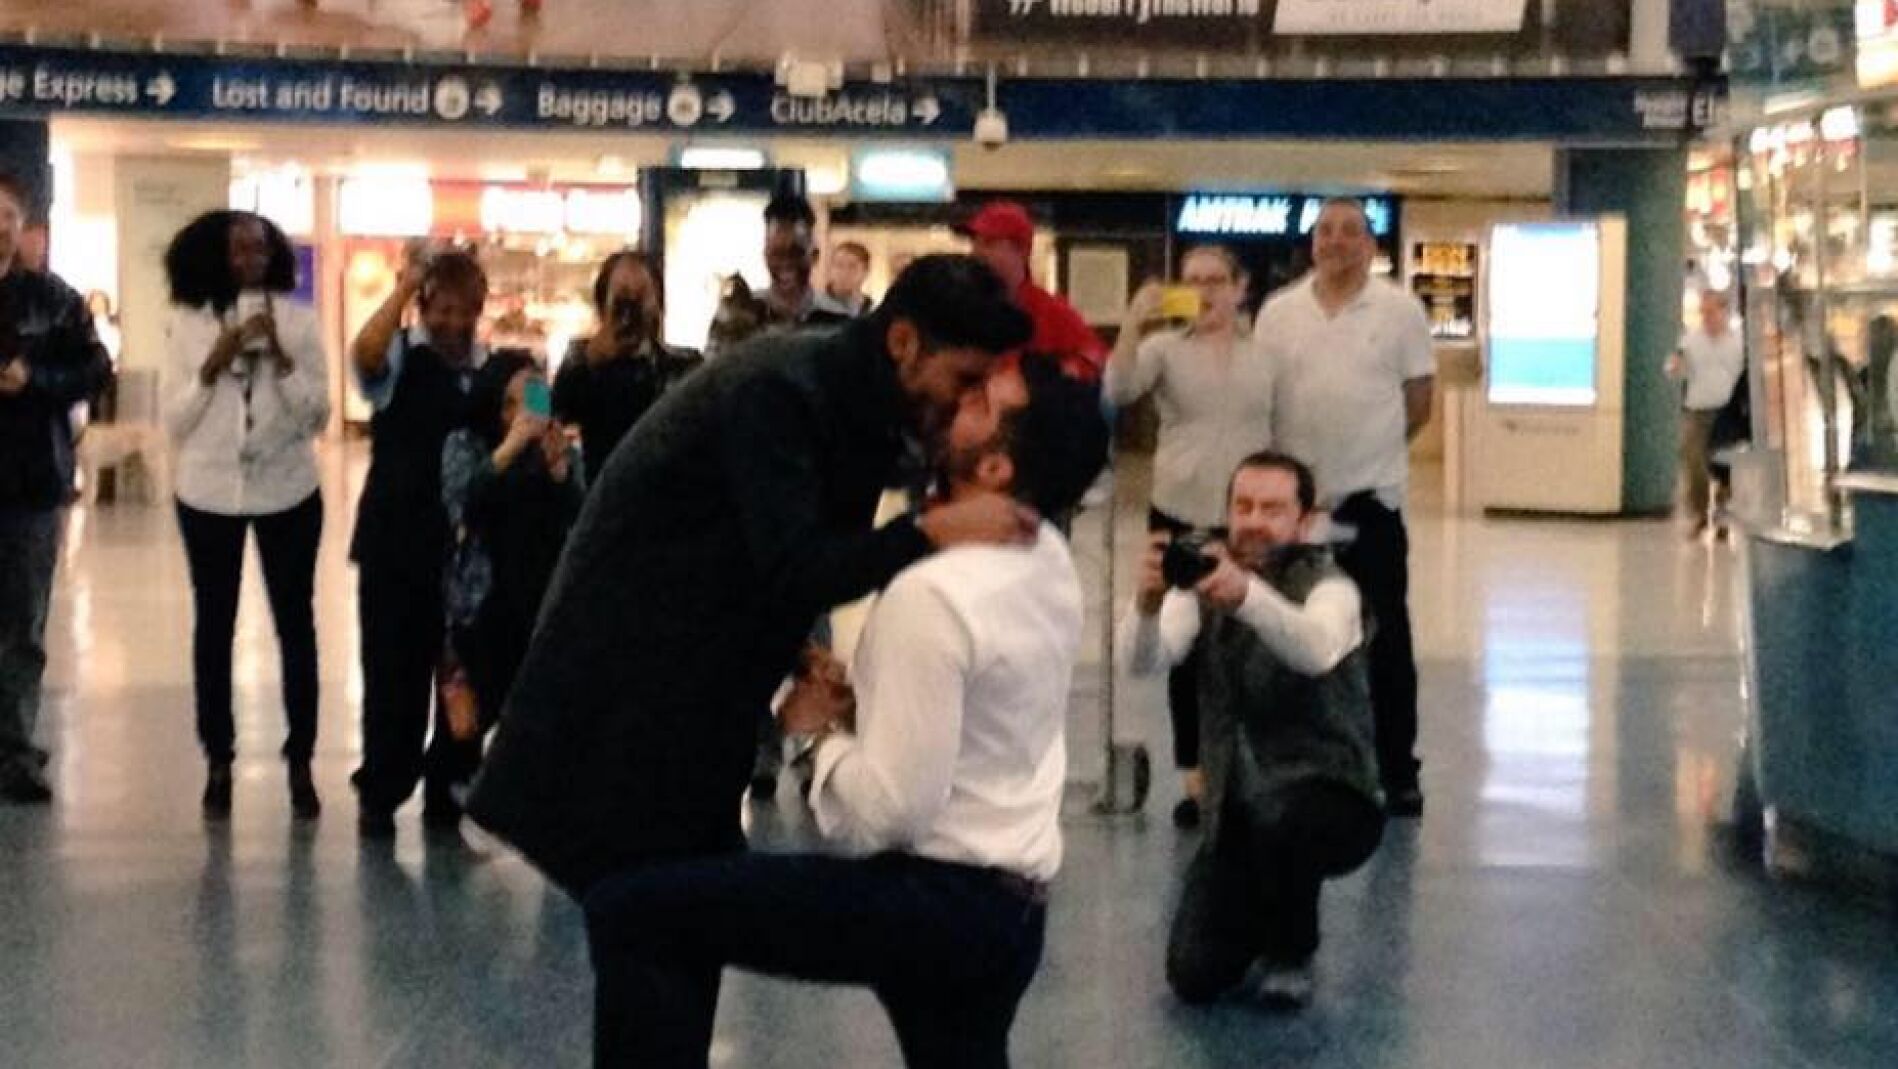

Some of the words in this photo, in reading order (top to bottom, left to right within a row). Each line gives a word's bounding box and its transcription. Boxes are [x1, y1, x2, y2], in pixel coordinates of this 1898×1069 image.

[33, 67, 138, 109] Express
[212, 75, 268, 109] Lost
[275, 77, 332, 111] and
[340, 77, 430, 113] Found
[537, 83, 661, 127] Baggage
[1177, 195, 1291, 234] AMTRAK
